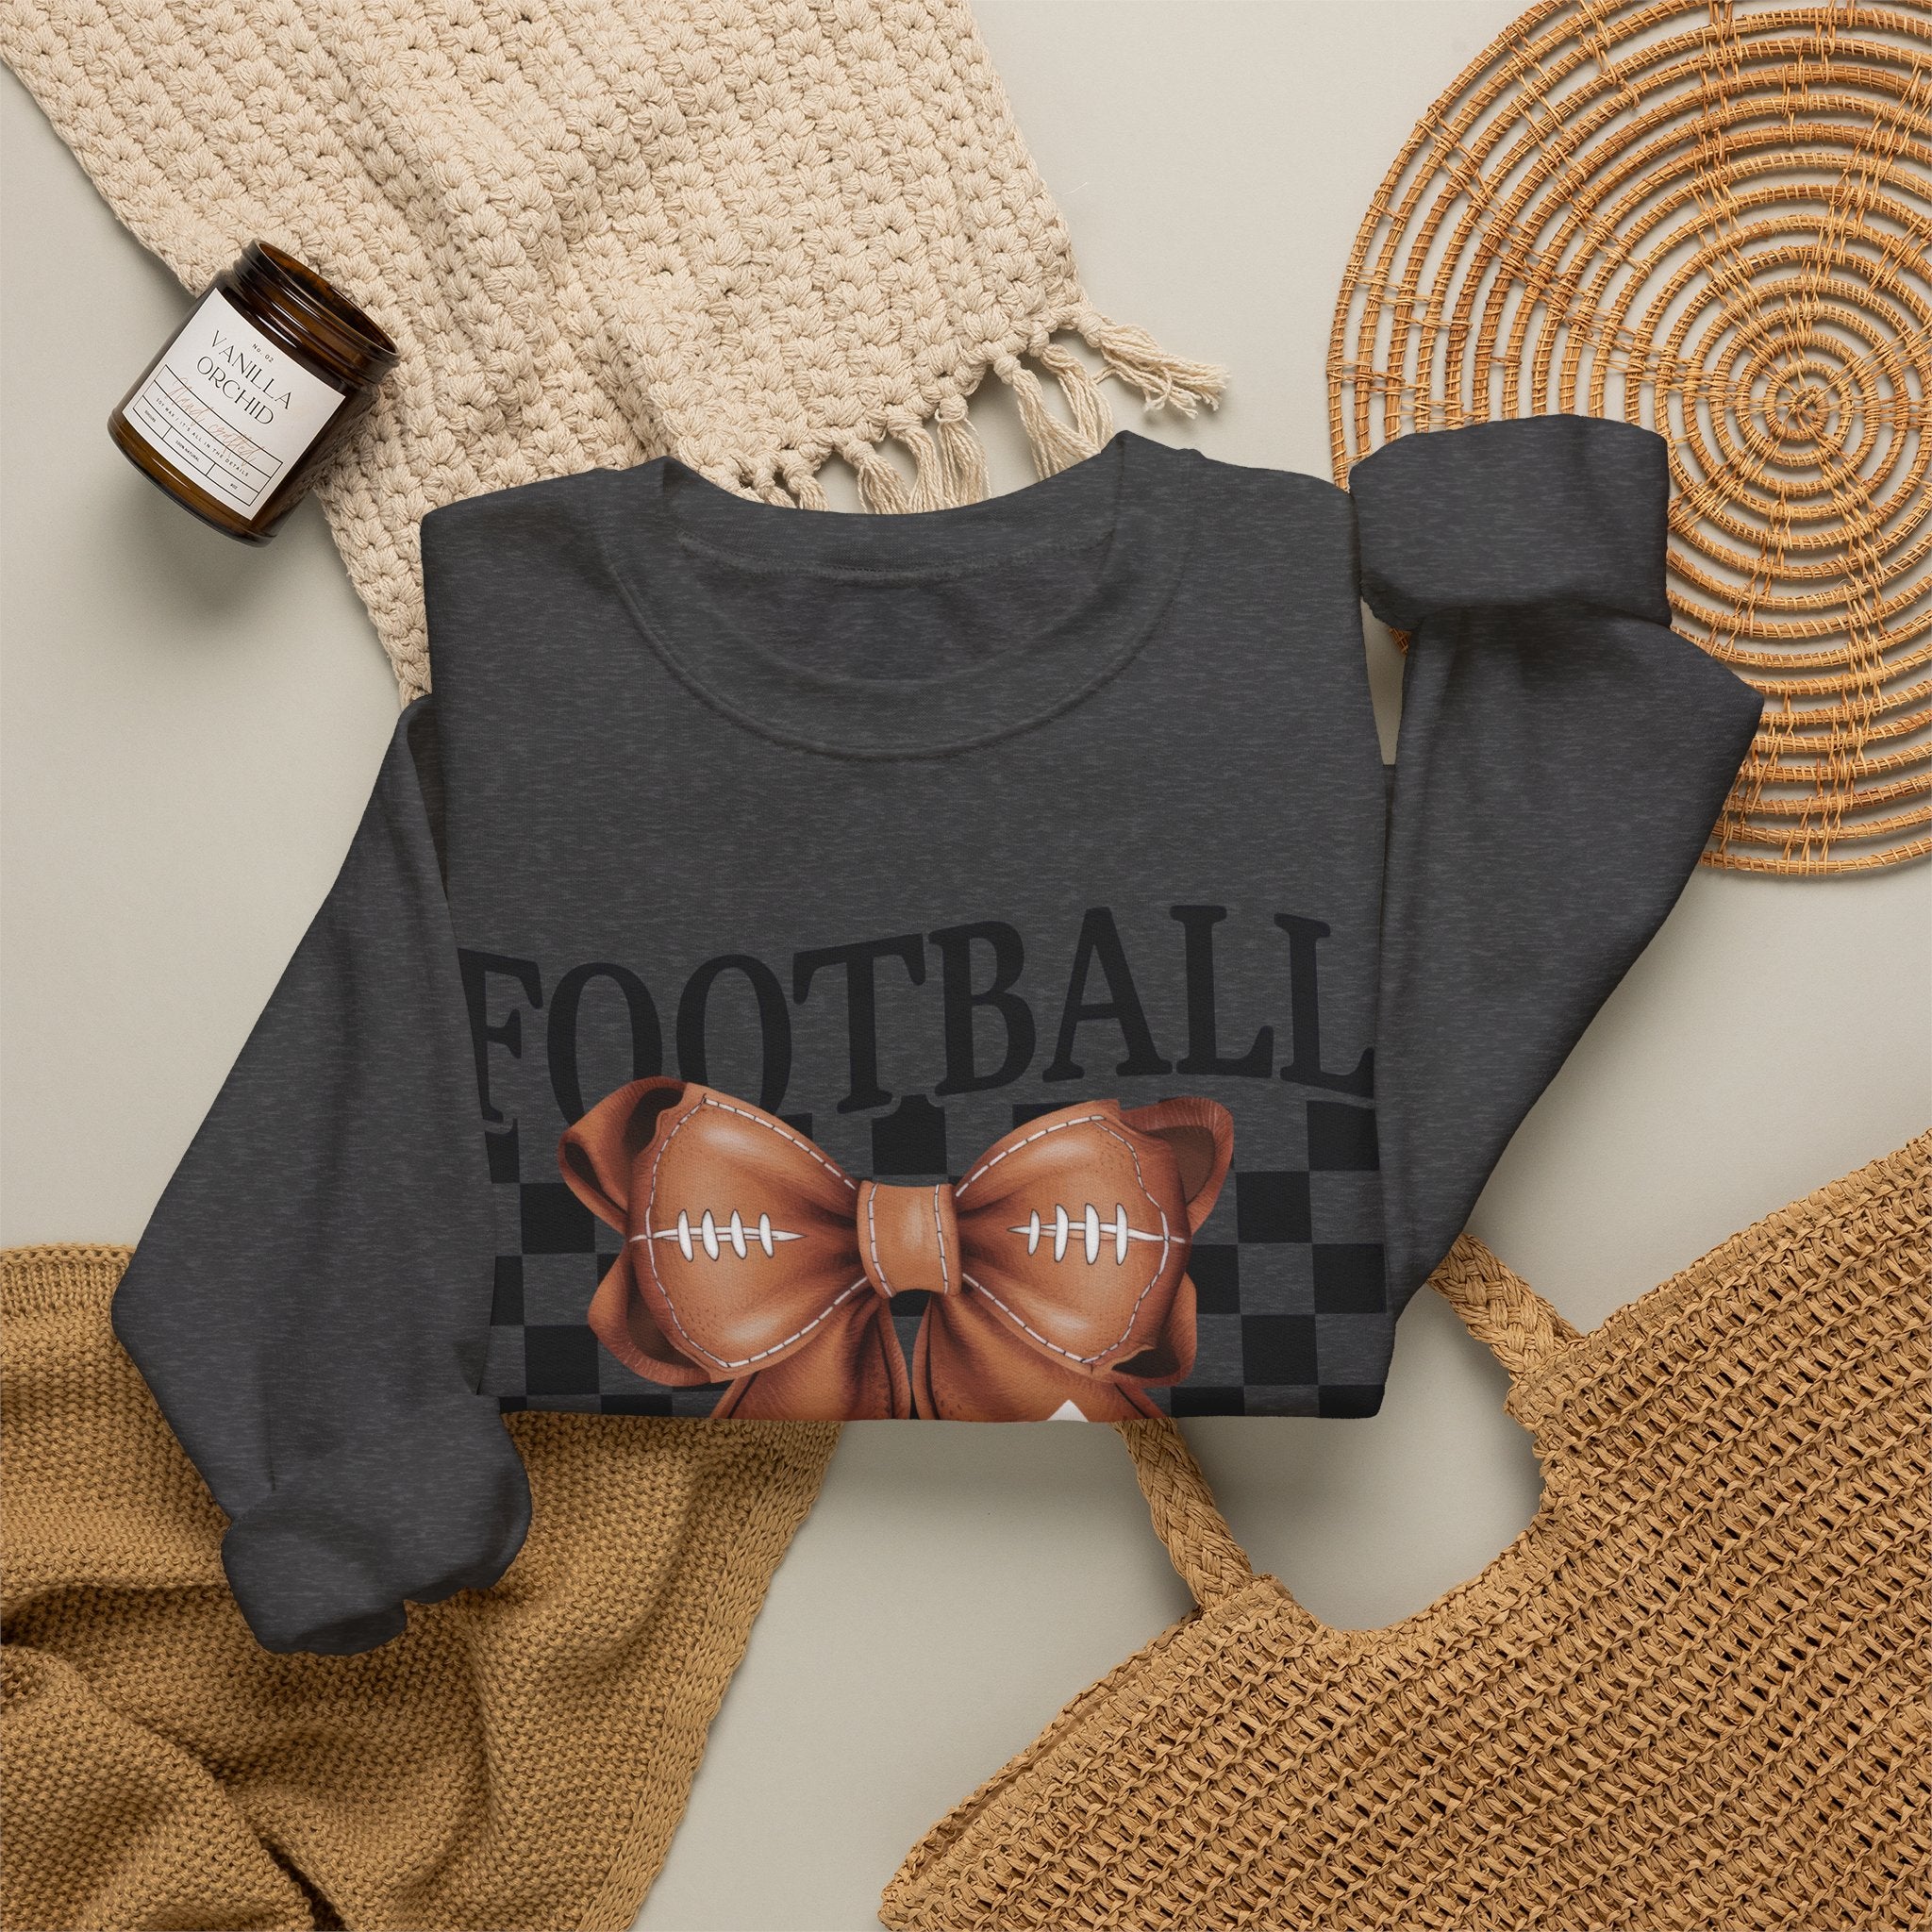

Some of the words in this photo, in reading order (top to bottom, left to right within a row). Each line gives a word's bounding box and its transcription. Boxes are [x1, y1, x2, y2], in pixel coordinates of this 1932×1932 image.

[196, 356, 275, 425] ORCHID
[211, 329, 291, 409] VANILLA
[264, 354, 275, 363] 02
[165, 407, 175, 417] WAX
[192, 432, 202, 441] ALL
[212, 448, 224, 458] THE
[225, 458, 249, 477] DETAILS
[458, 904, 1375, 1126] FOOTBALL
